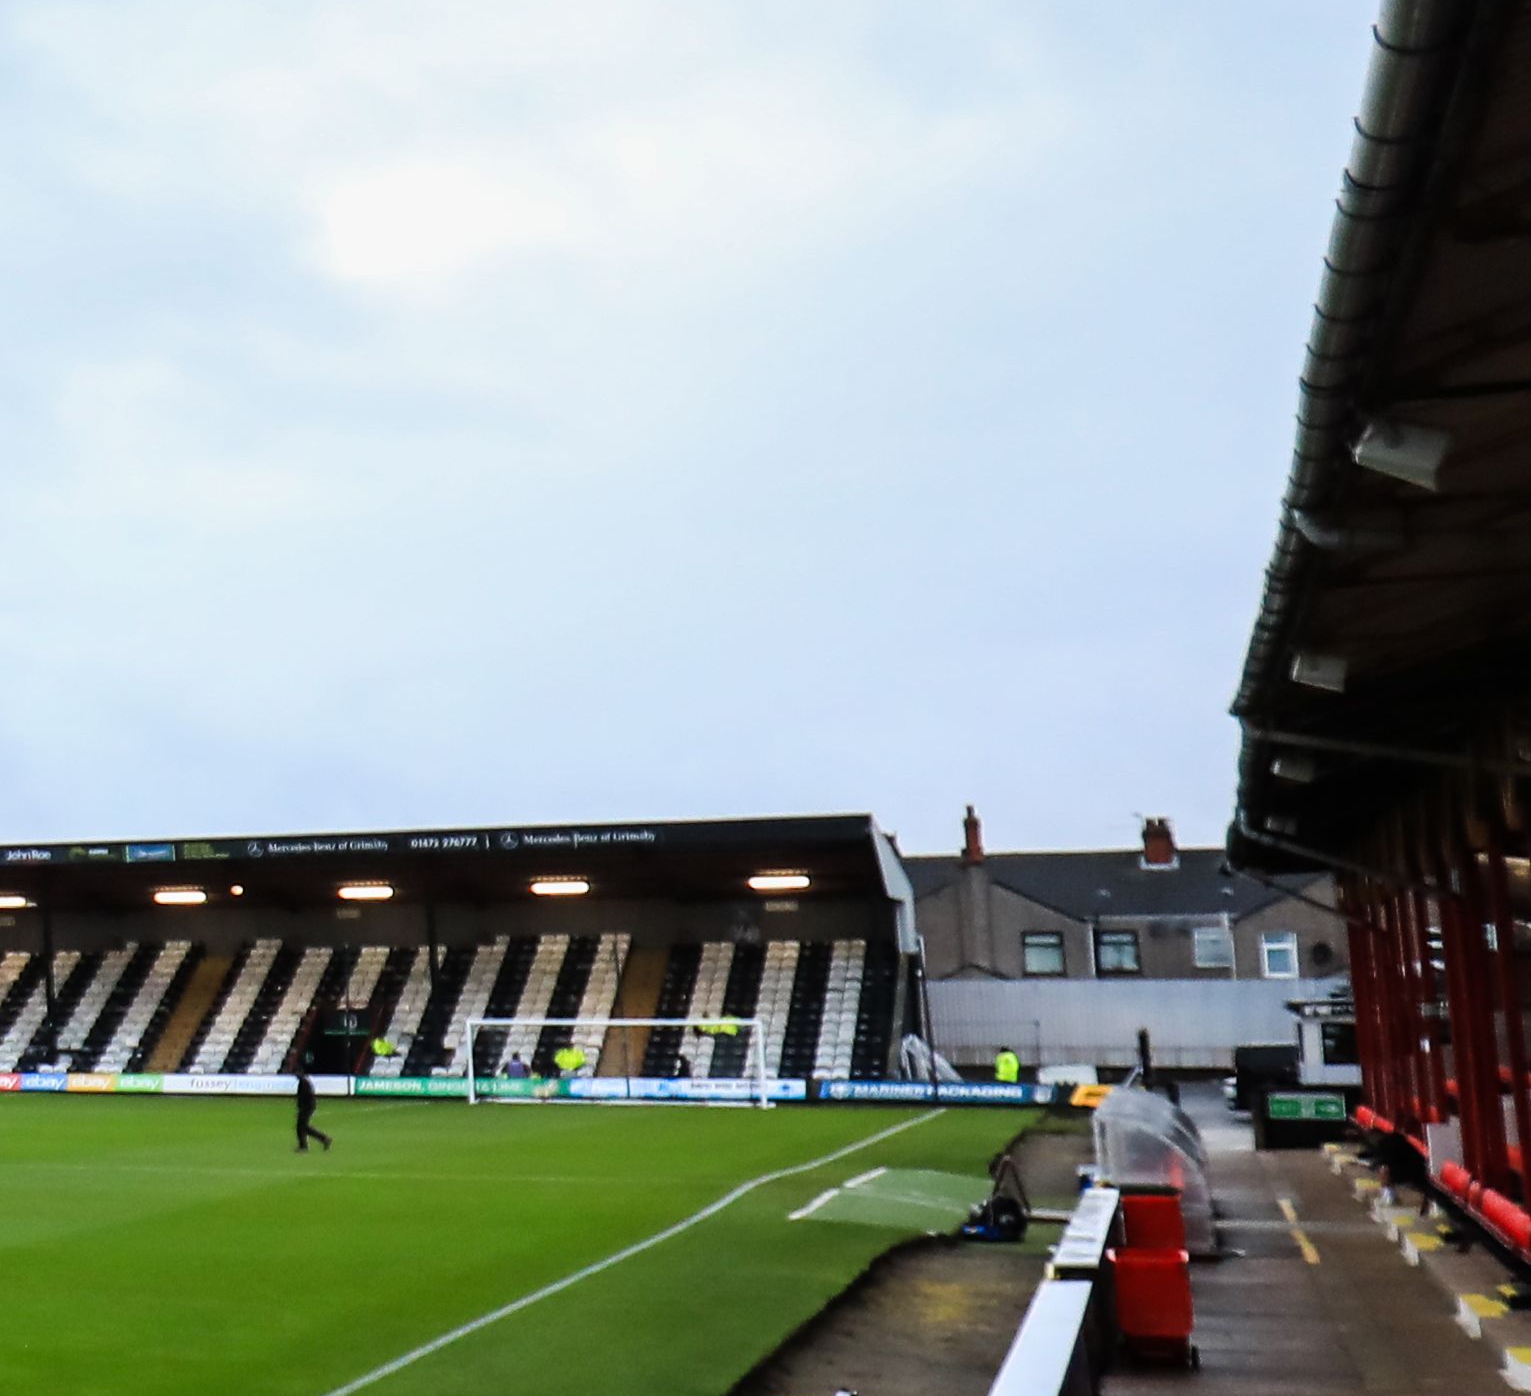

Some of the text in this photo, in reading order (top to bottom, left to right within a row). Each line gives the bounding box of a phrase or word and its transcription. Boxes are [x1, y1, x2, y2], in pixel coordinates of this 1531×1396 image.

[26, 1074, 65, 1088] ebay
[71, 1074, 111, 1089] ebay
[119, 1075, 159, 1090] ebay
